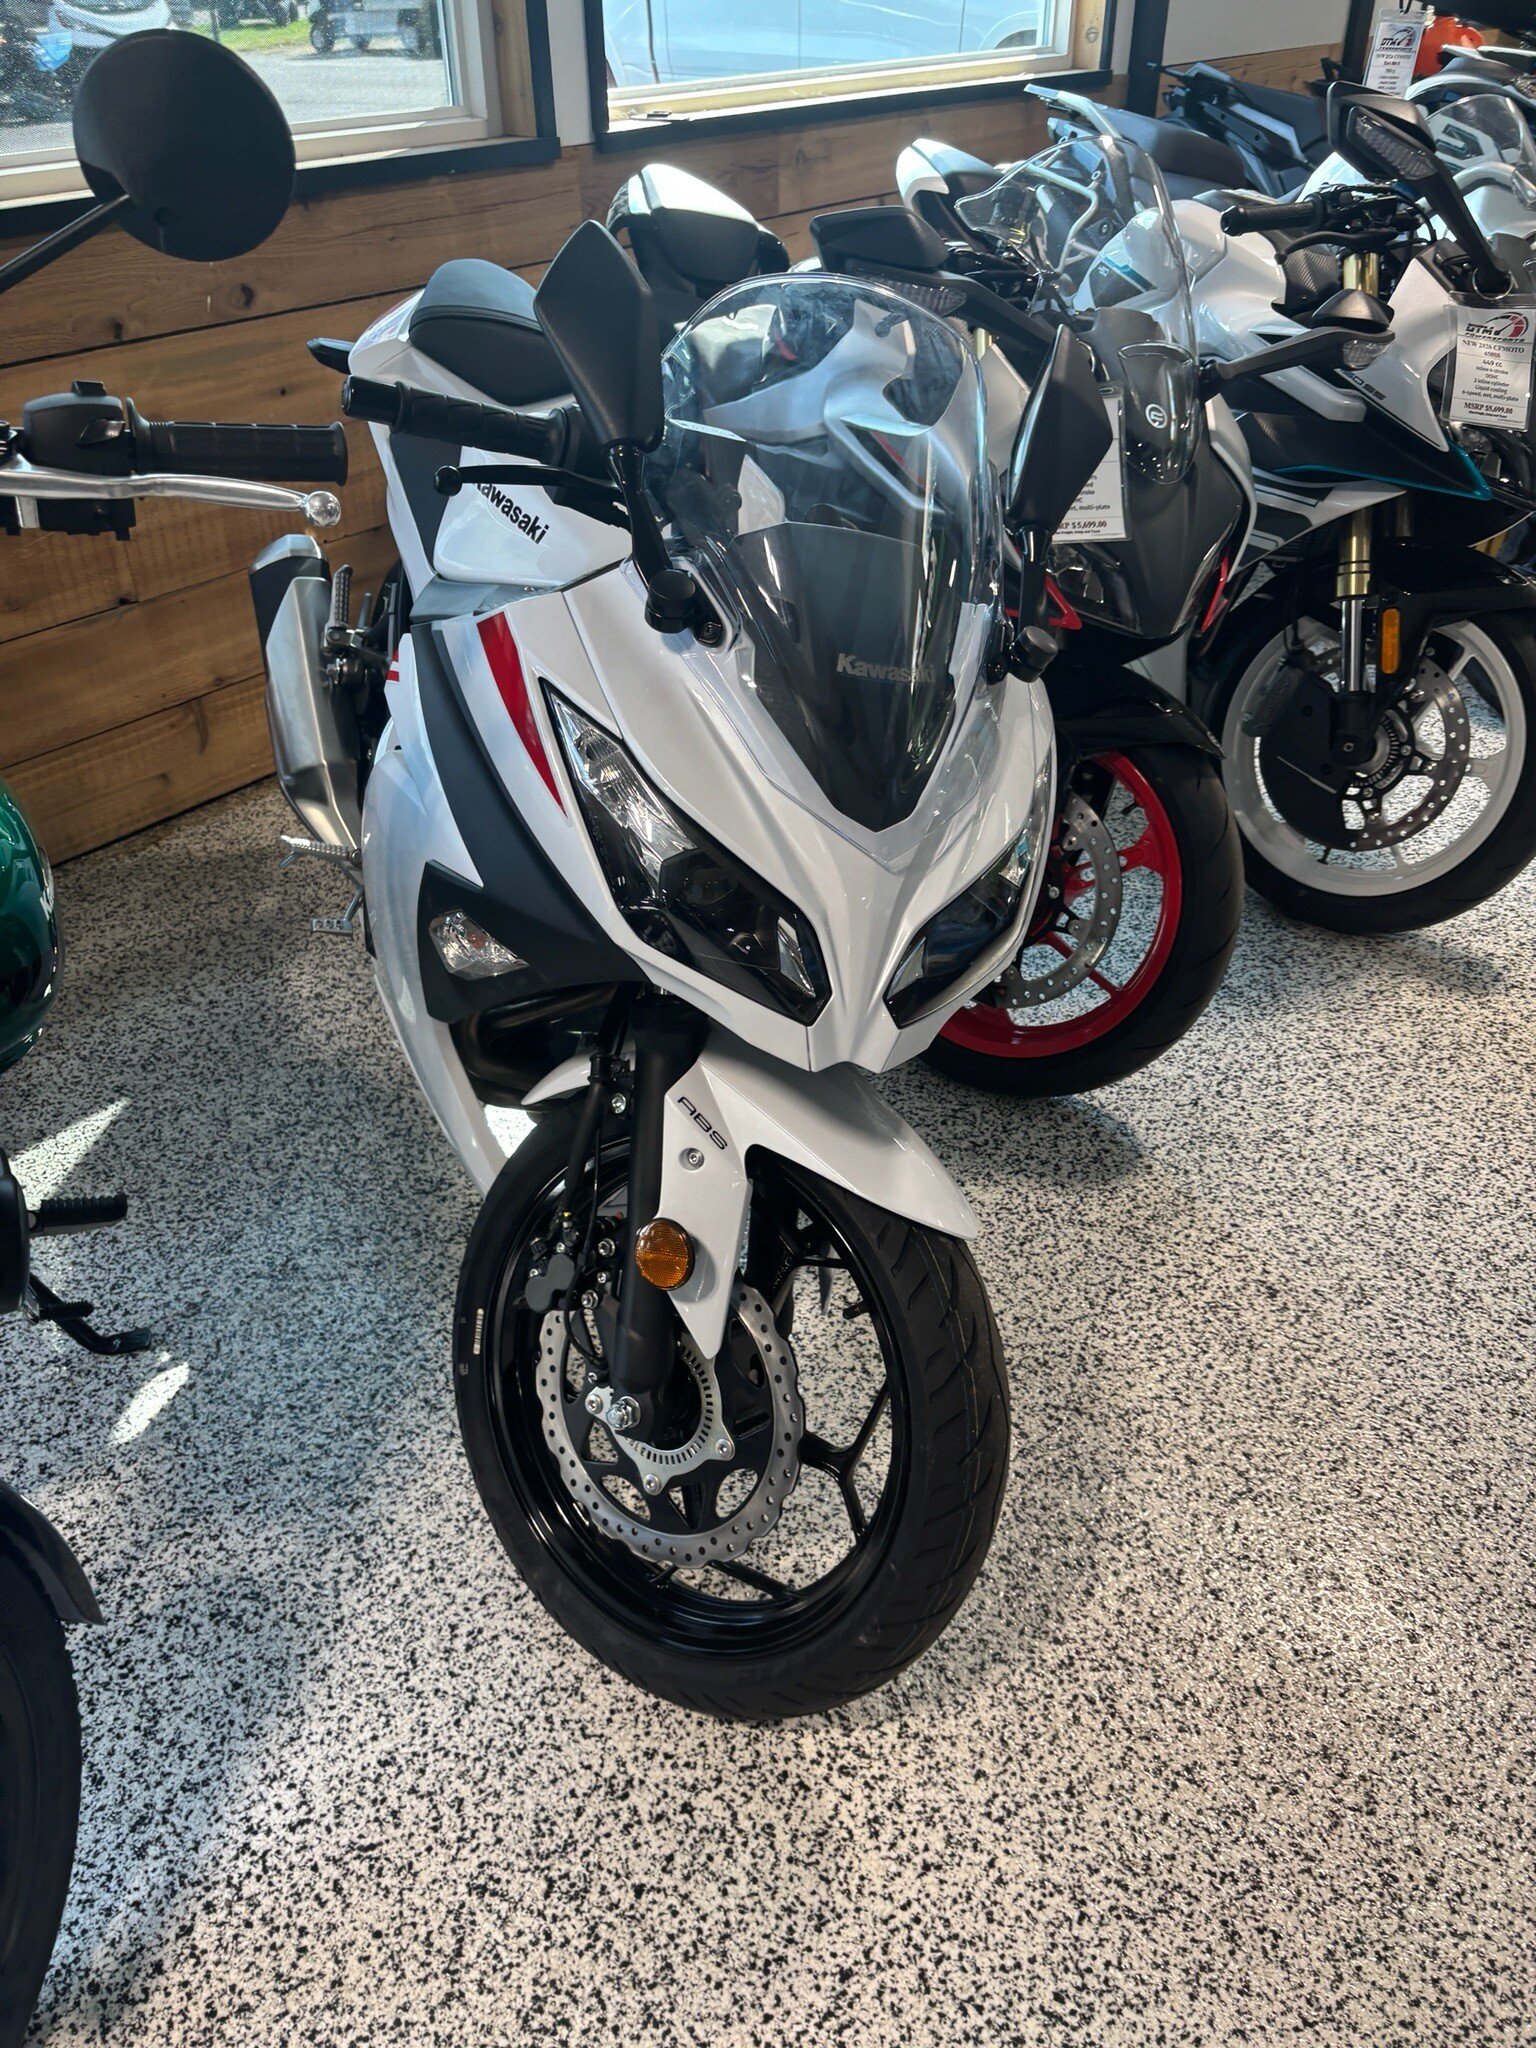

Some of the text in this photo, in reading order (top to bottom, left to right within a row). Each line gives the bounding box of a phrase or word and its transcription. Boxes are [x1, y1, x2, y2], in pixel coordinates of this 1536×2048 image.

[1466, 323, 1495, 335] DTM
[1462, 339, 1477, 348] NEW
[1493, 344, 1525, 354] CFMOTO
[1464, 402, 1484, 410] MSRP
[473, 483, 549, 544] awasaki
[677, 1096, 728, 1150] ABS
